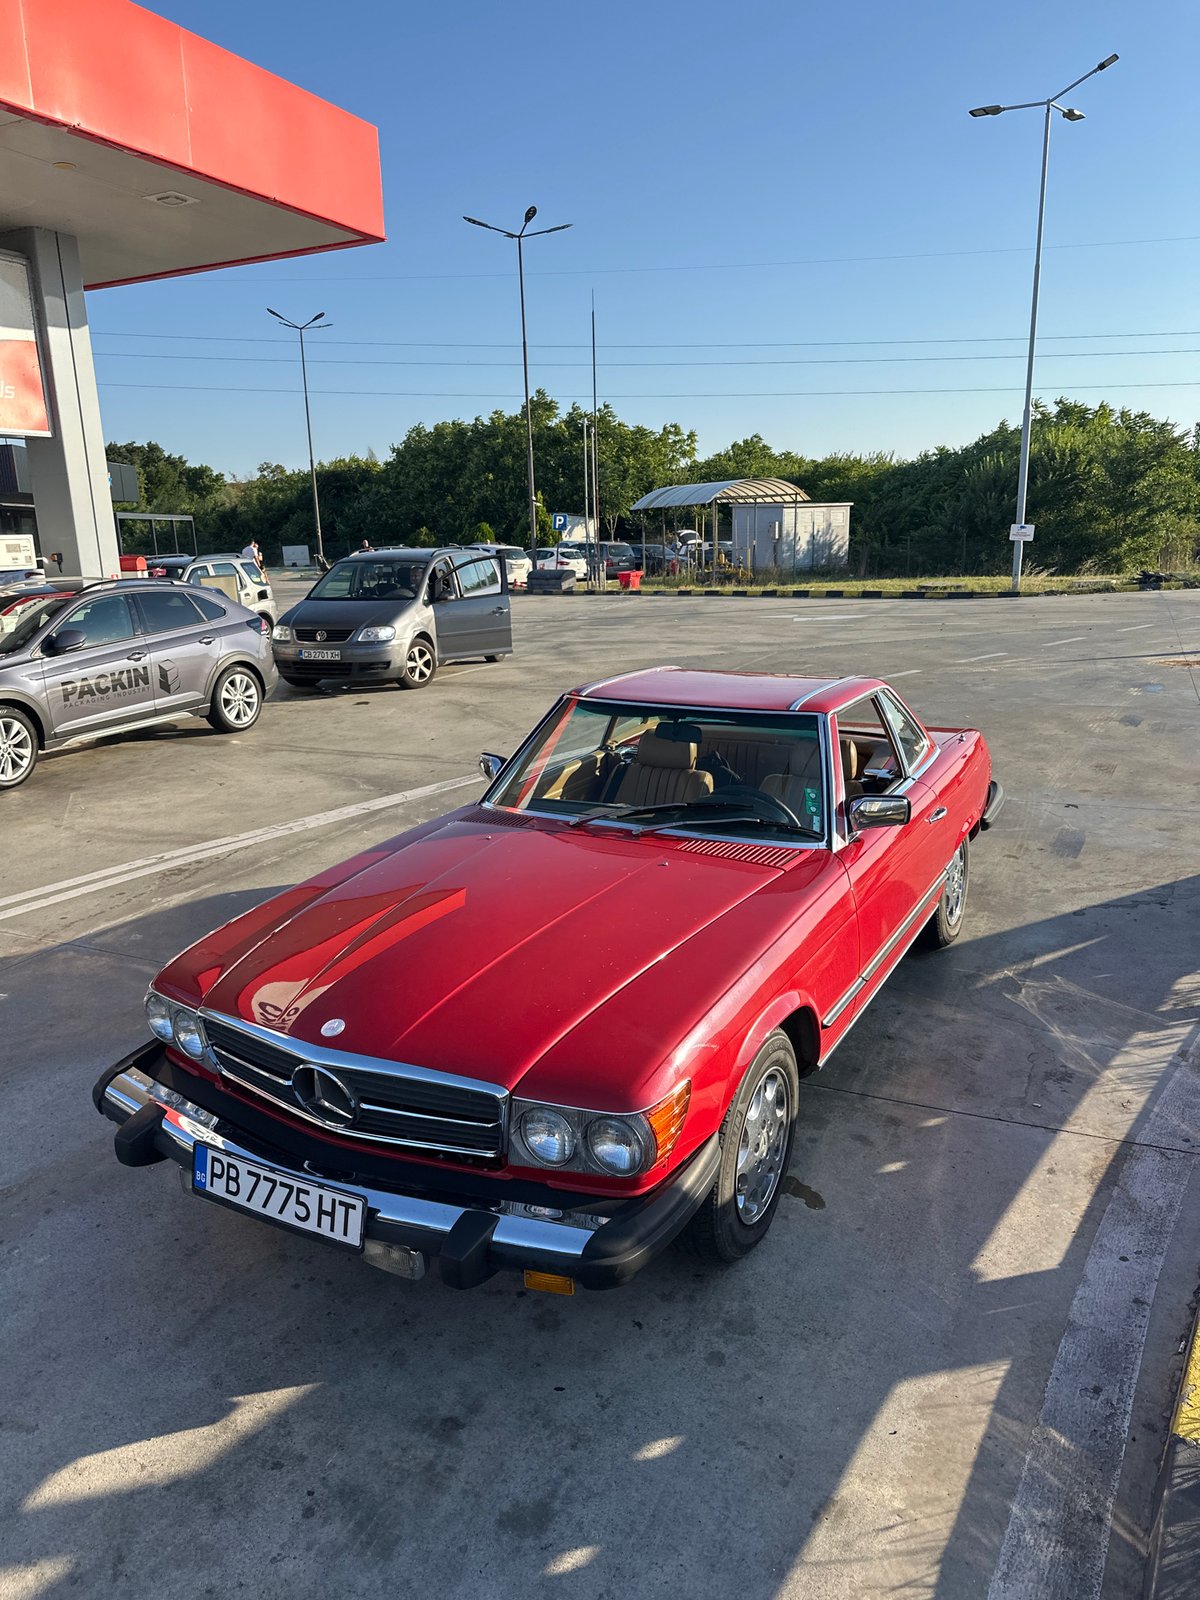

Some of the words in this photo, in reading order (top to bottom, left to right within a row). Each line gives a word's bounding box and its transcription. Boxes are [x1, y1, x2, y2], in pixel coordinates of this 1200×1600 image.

[555, 516, 564, 529] P
[60, 666, 150, 702] PACKIN
[63, 694, 111, 709] PACKAGING
[113, 686, 151, 698] INDUSTRY
[196, 1170, 206, 1183] BG
[210, 1155, 240, 1197] PB
[246, 1169, 311, 1223] 7775
[316, 1194, 356, 1237] HT
